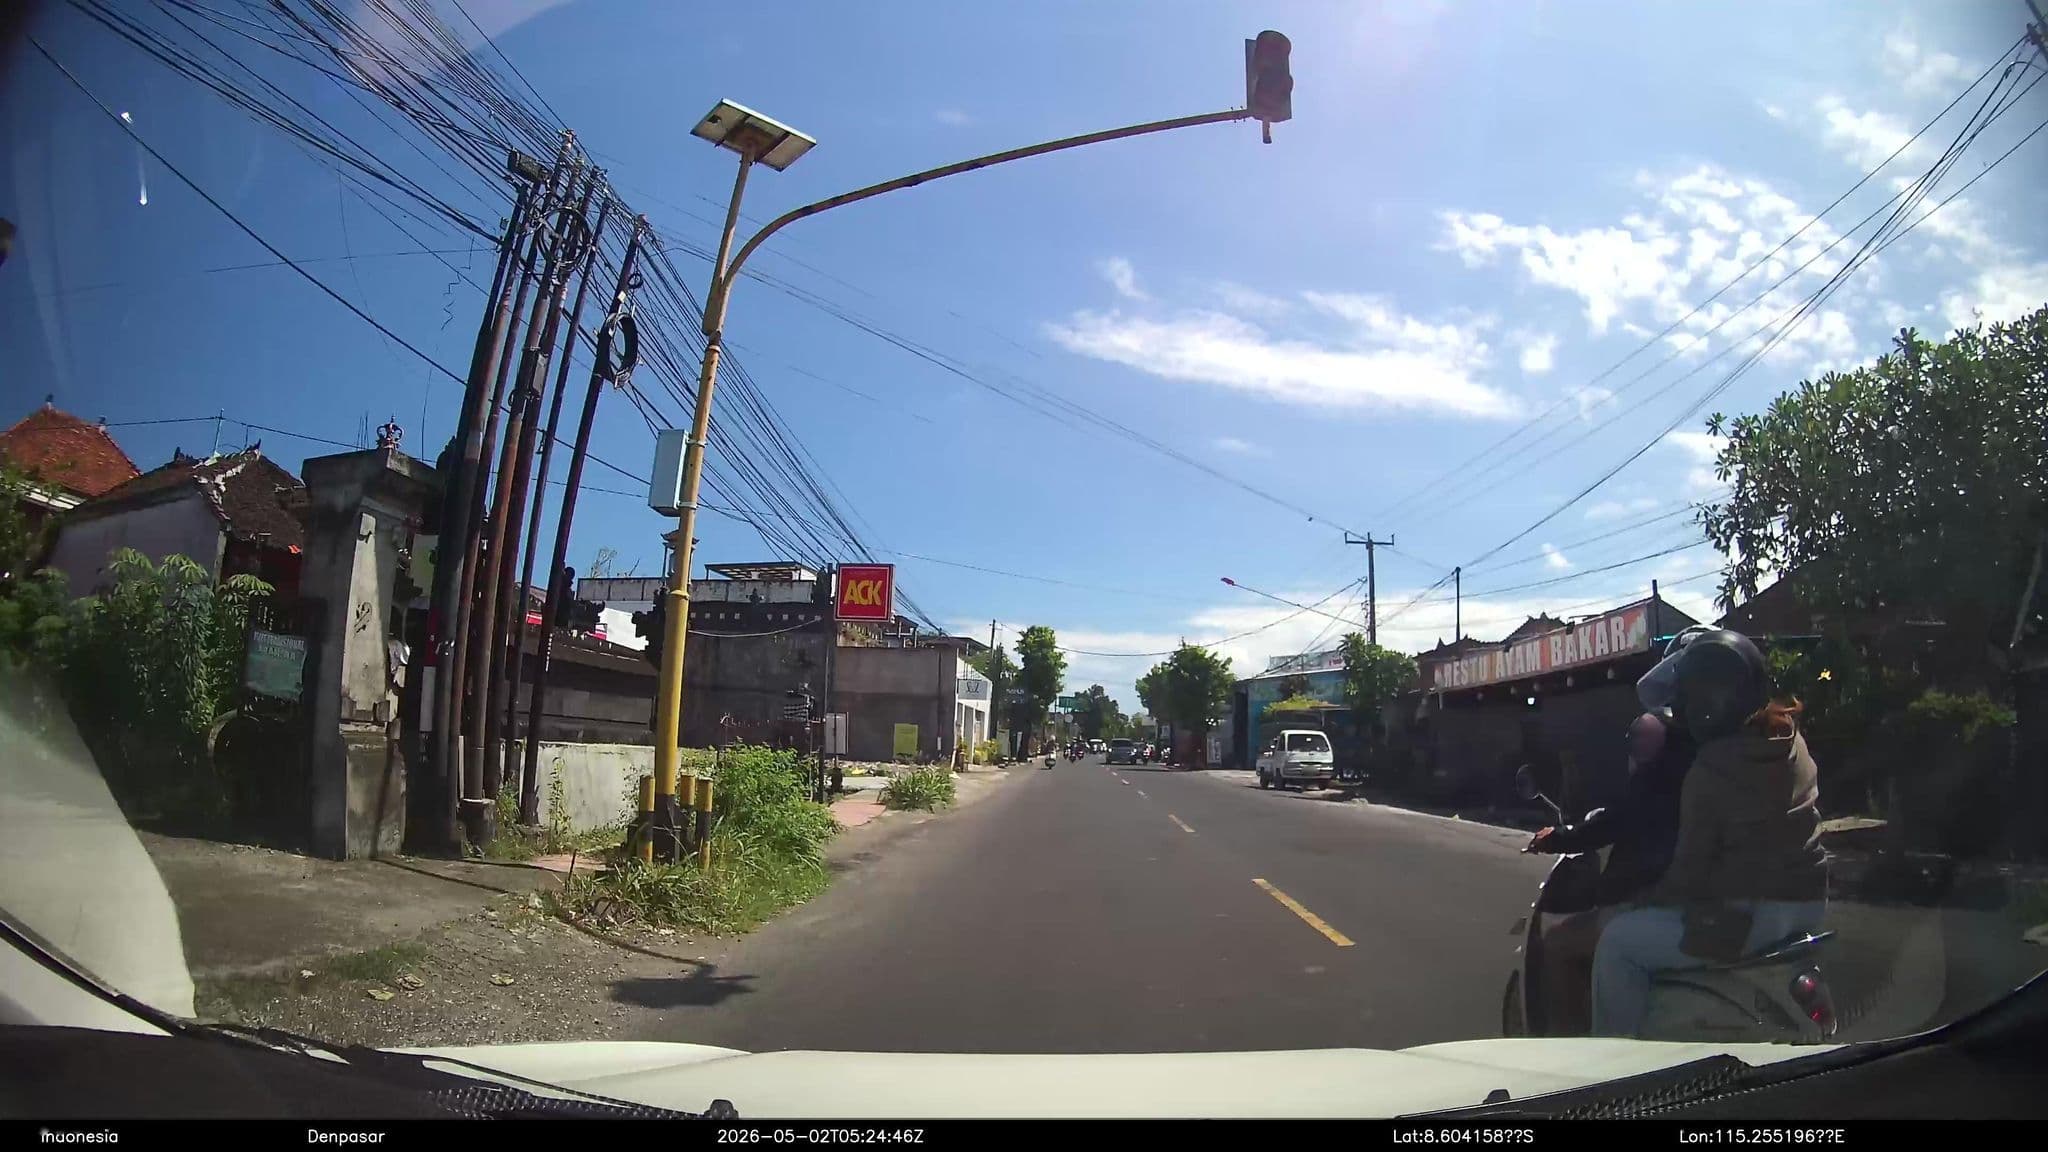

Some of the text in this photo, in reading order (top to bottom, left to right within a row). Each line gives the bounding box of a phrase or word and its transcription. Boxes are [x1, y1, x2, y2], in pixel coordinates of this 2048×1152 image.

[843, 580, 883, 606] ACK
[1495, 639, 1541, 680] AYAM
[1551, 616, 1626, 667] BAKAR
